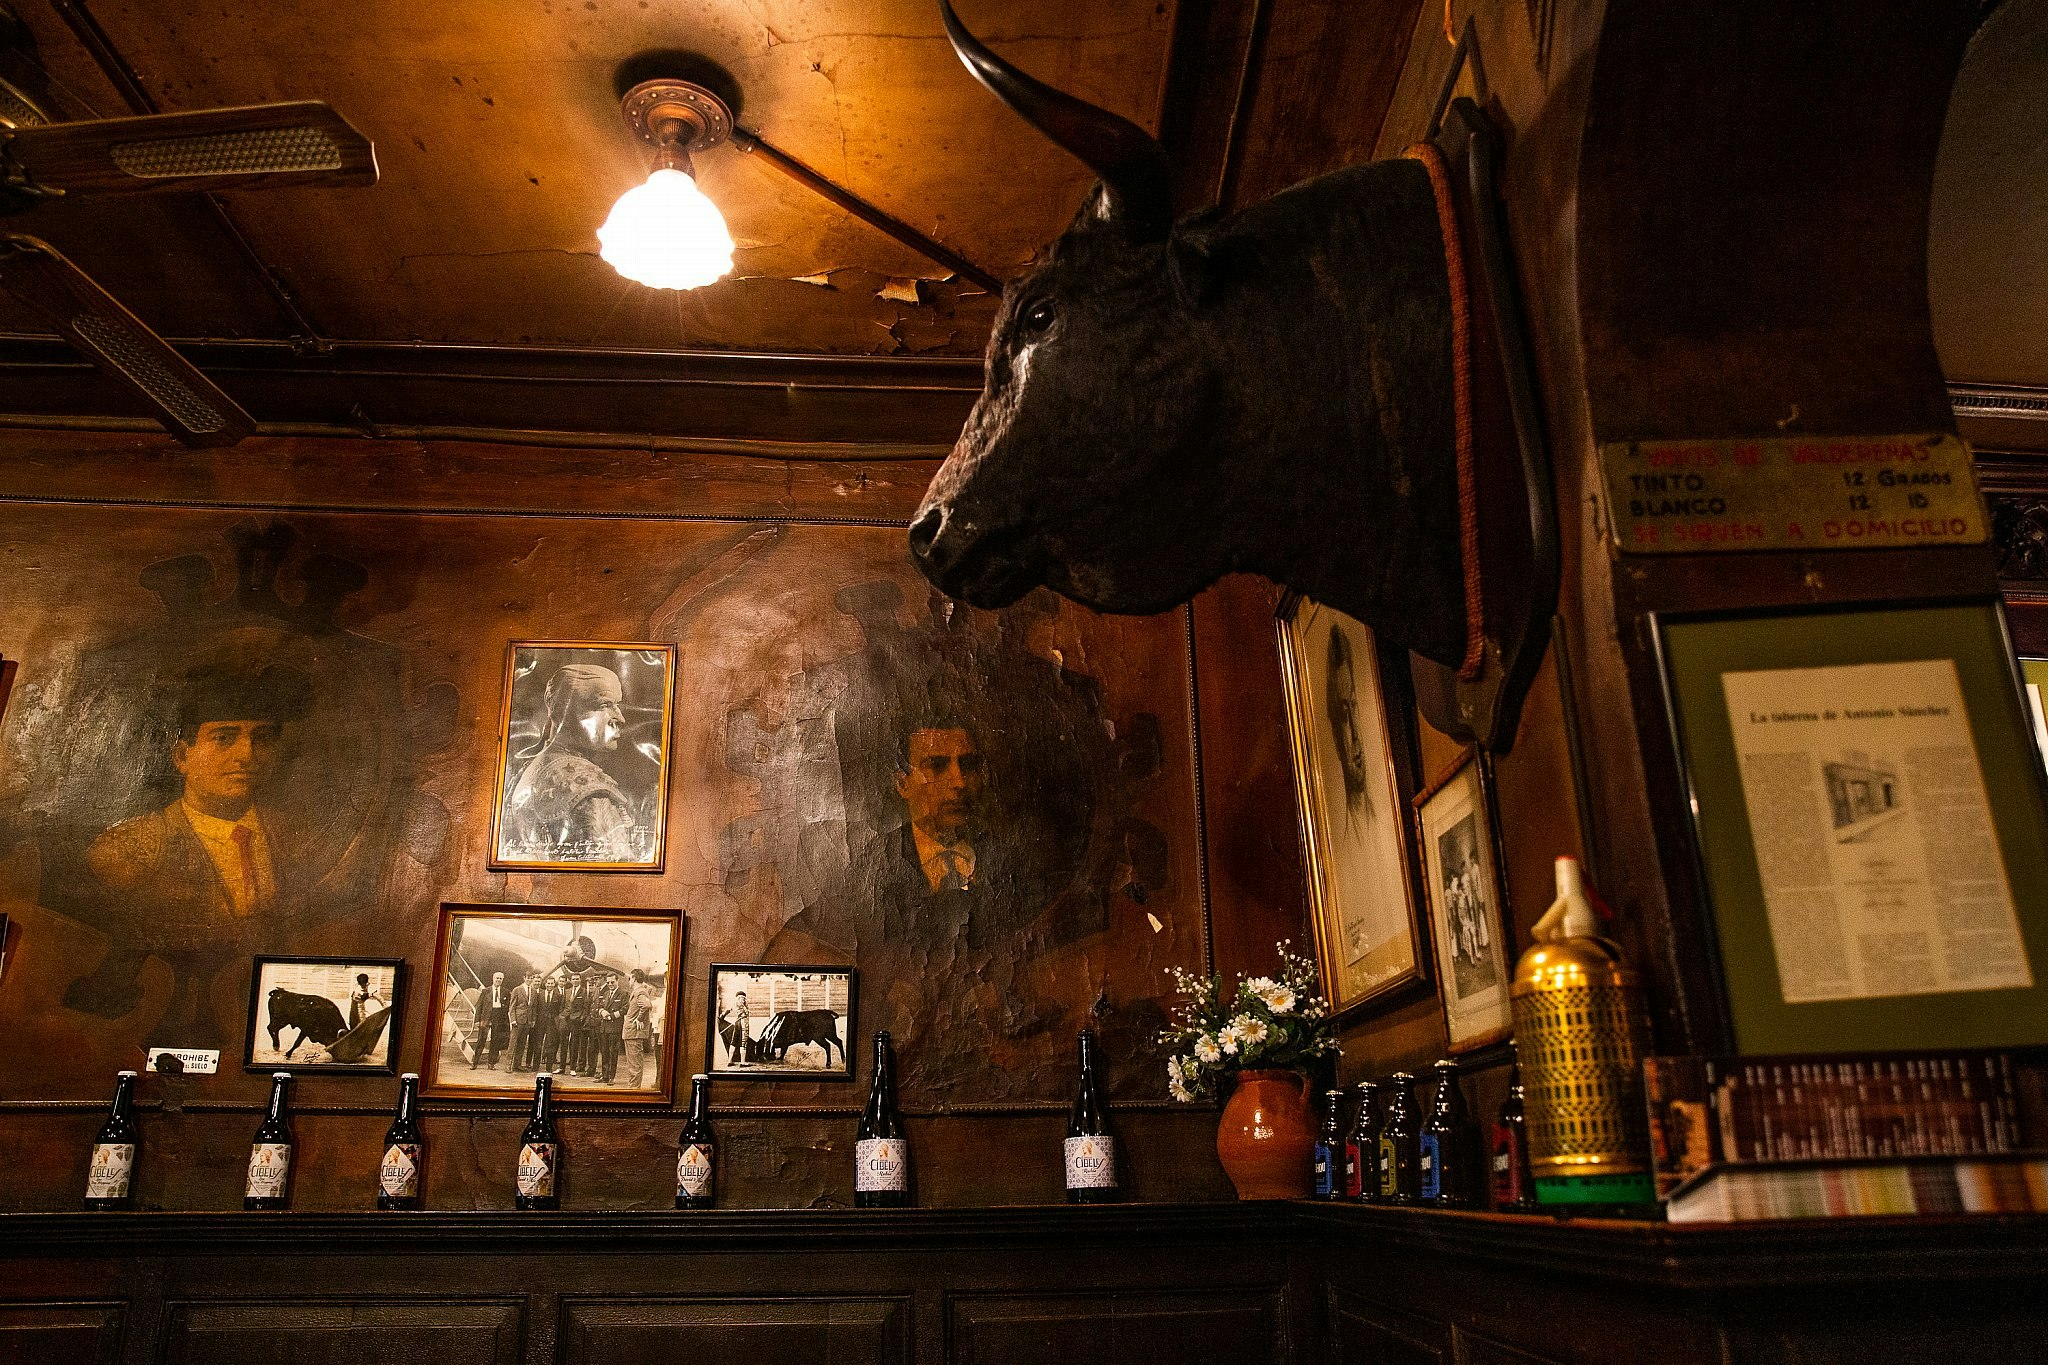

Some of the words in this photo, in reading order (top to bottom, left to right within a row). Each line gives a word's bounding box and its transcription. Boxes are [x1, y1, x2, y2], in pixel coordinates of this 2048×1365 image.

[1630, 474, 1704, 492] TINTO
[1843, 472, 1865, 486] 12
[1630, 499, 1726, 517] BLANCO
[1849, 494, 1871, 511] 12
[1633, 525, 1659, 543] SE
[1673, 523, 1764, 542] SIRVEN
[1788, 522, 1803, 539] A
[1823, 518, 1967, 538] DOMICILIO
[1750, 711, 1767, 724] La
[1771, 711, 1819, 723] taberna
[1822, 709, 1837, 721] de
[1844, 707, 1894, 719] Antonio
[175, 1054, 209, 1062] ROHIBE
[870, 1158, 900, 1172] CIBELES
[1076, 1156, 1106, 1170] CIBELES
[680, 1164, 709, 1180] CIBELES
